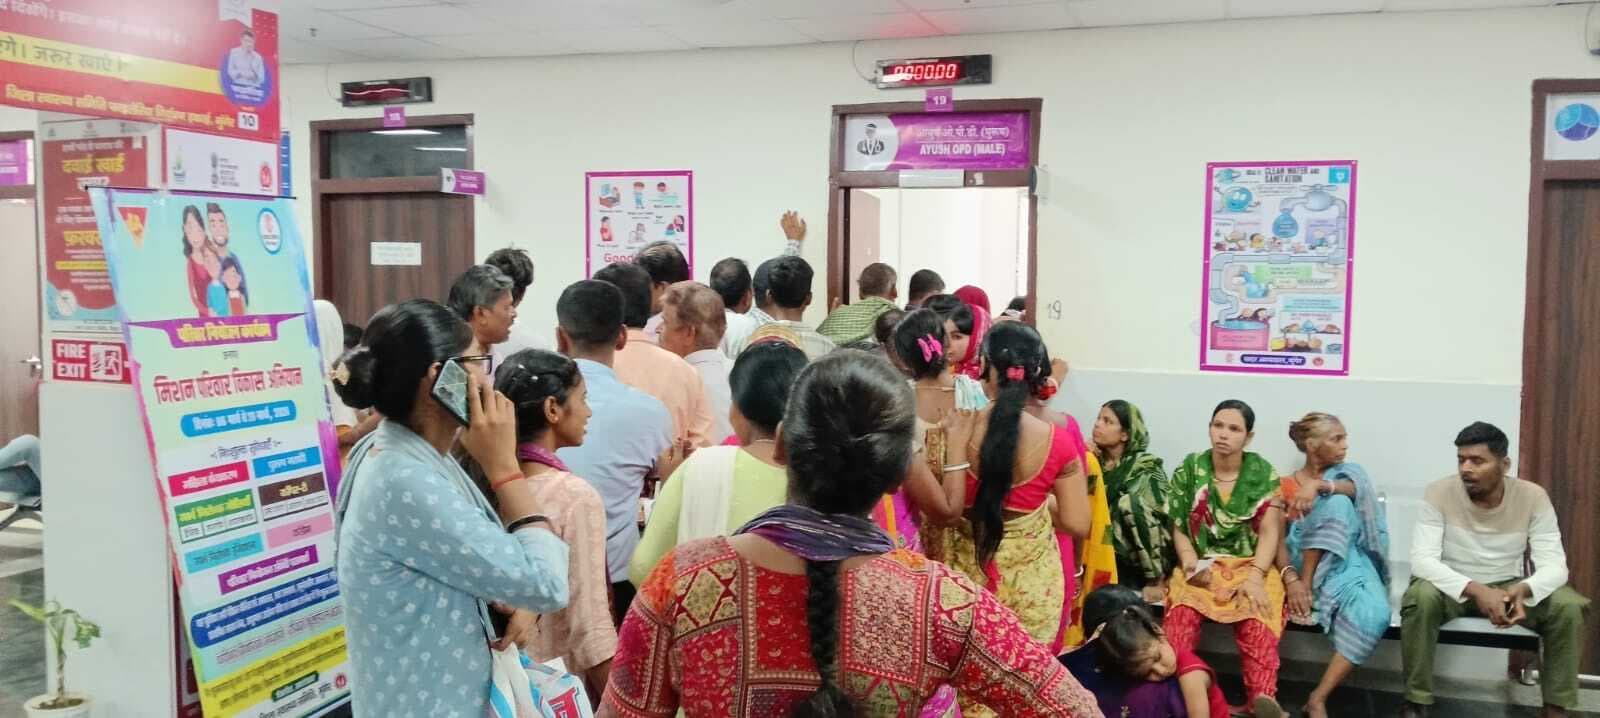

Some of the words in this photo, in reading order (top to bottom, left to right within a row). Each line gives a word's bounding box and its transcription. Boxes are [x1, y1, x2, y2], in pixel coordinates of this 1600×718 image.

[933, 95, 946, 105] 19
[242, 115, 255, 127] 10
[920, 143, 950, 155] AYUSH
[952, 143, 971, 154] OPD
[973, 143, 1006, 156] (MALE)
[56, 343, 86, 358] FIRE
[57, 363, 85, 378] EXIT
[154, 375, 196, 404] मिशन
[197, 370, 232, 398] परिवार
[232, 367, 266, 393] विकास
[268, 363, 303, 388] अभियान
